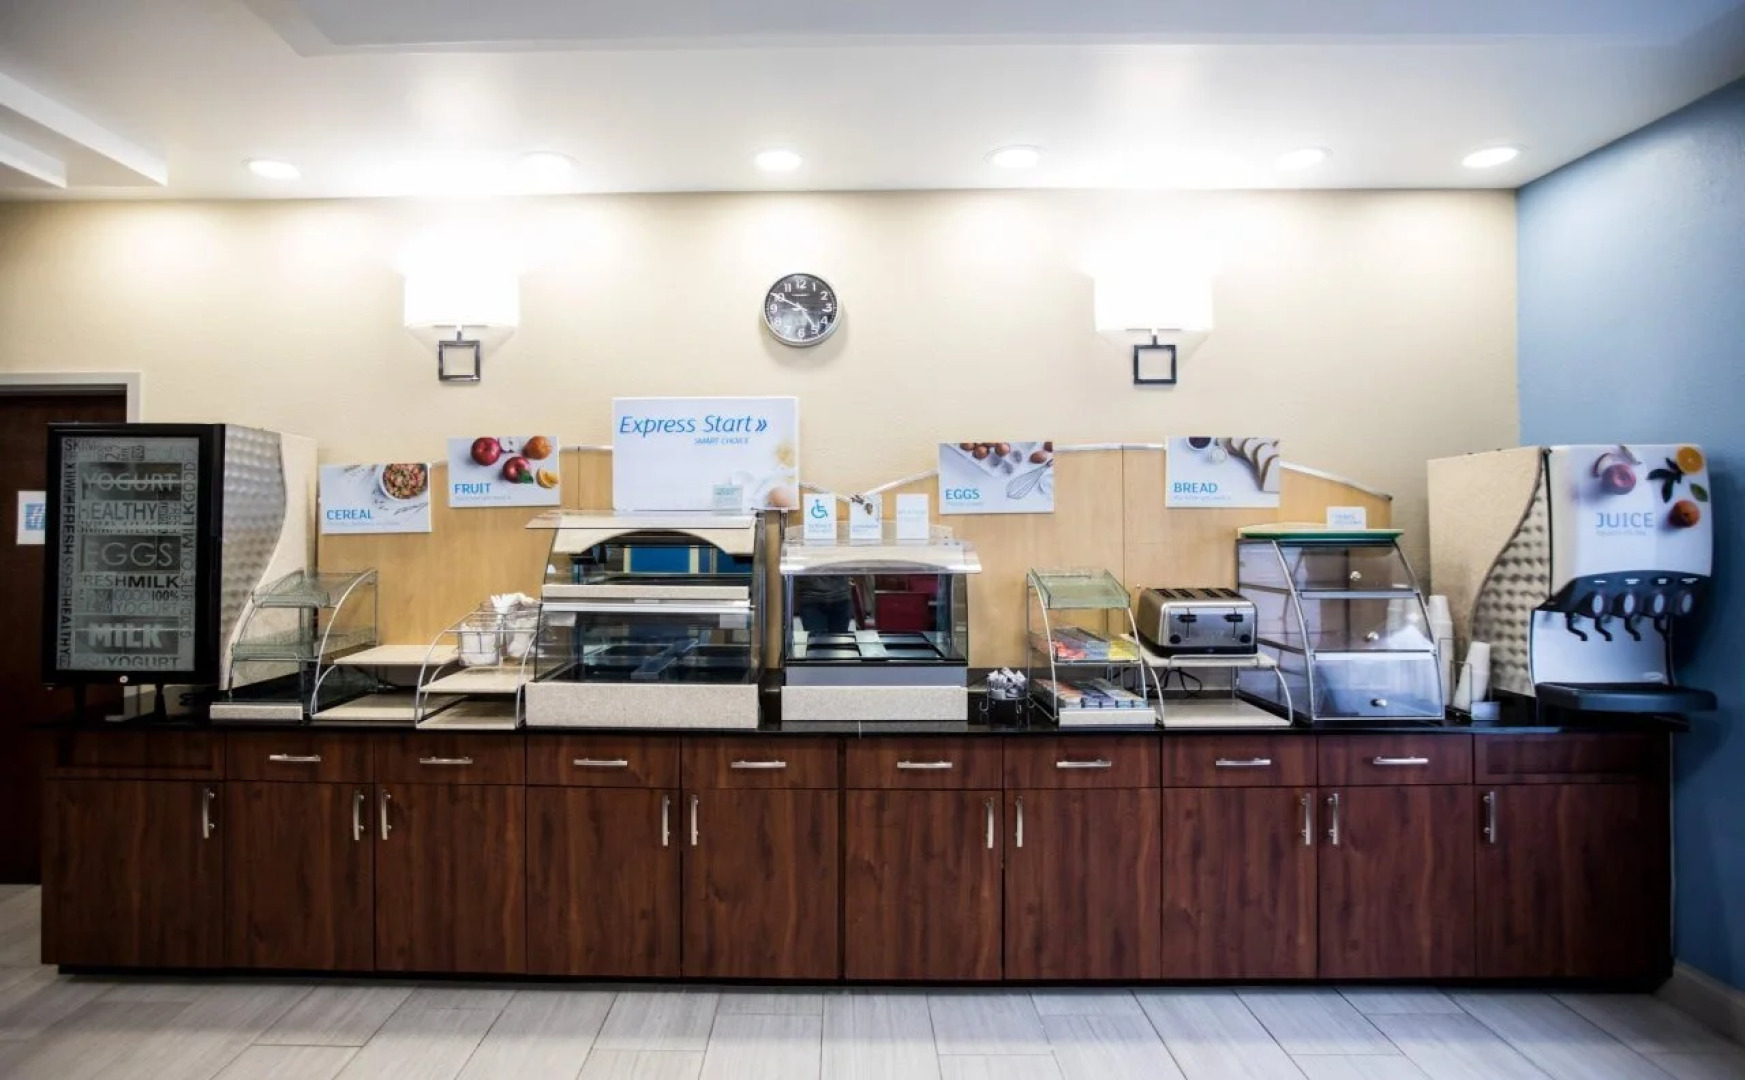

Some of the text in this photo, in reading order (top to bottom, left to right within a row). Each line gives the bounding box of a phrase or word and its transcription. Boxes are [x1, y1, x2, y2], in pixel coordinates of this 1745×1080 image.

[784, 283, 792, 293] 11
[795, 280, 807, 289] 12
[820, 291, 828, 301] 2
[821, 303, 833, 313] 3
[820, 316, 829, 325] 4
[798, 328, 805, 338] 6
[619, 414, 752, 438] Express Start
[82, 472, 178, 492] YOGURT
[1173, 482, 1218, 493] BREAD
[454, 482, 492, 494] FRUIT
[945, 488, 980, 500] EGGS
[78, 502, 158, 521] HEALTHY
[326, 509, 372, 520] CEREAL
[1595, 512, 1655, 528] JUICE
[84, 542, 174, 567] EGGS
[87, 622, 163, 648] MILK
